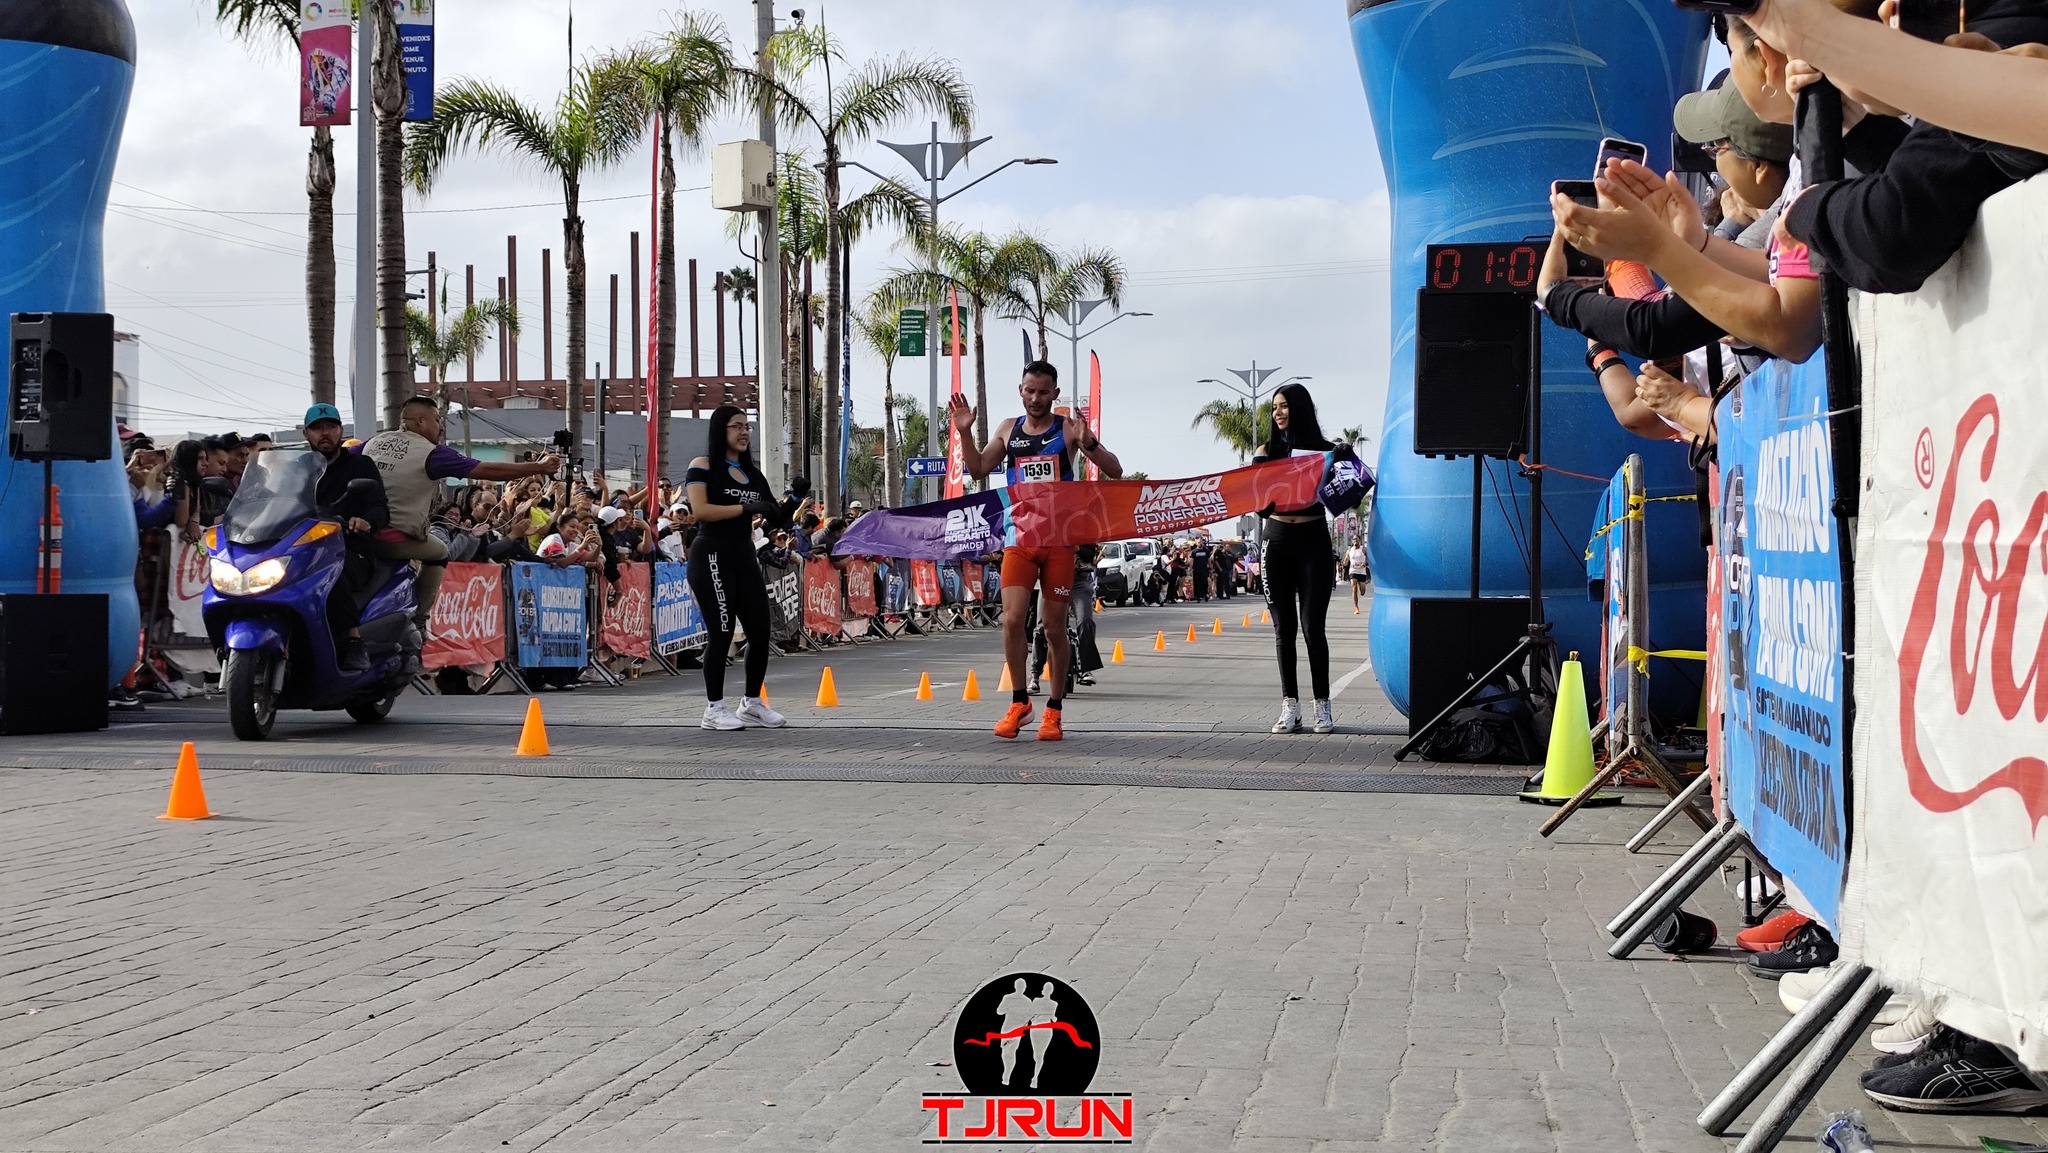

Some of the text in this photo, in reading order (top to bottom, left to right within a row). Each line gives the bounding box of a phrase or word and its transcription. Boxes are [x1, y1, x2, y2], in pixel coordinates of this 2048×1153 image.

[927, 462, 946, 472] RUTA
[1024, 462, 1051, 477] 1539
[1138, 475, 1223, 502] MEDIO
[1133, 491, 1224, 514] MARATON
[1134, 502, 1228, 526] POWERADE
[946, 503, 989, 531] 21K
[1137, 520, 1194, 534] ROSARITO
[944, 530, 991, 543] ROSARITO
[1260, 538, 1275, 604] POWERADE
[708, 552, 729, 632] POWERADE
[765, 571, 799, 603] POWER
[1898, 393, 2048, 840] Coc
